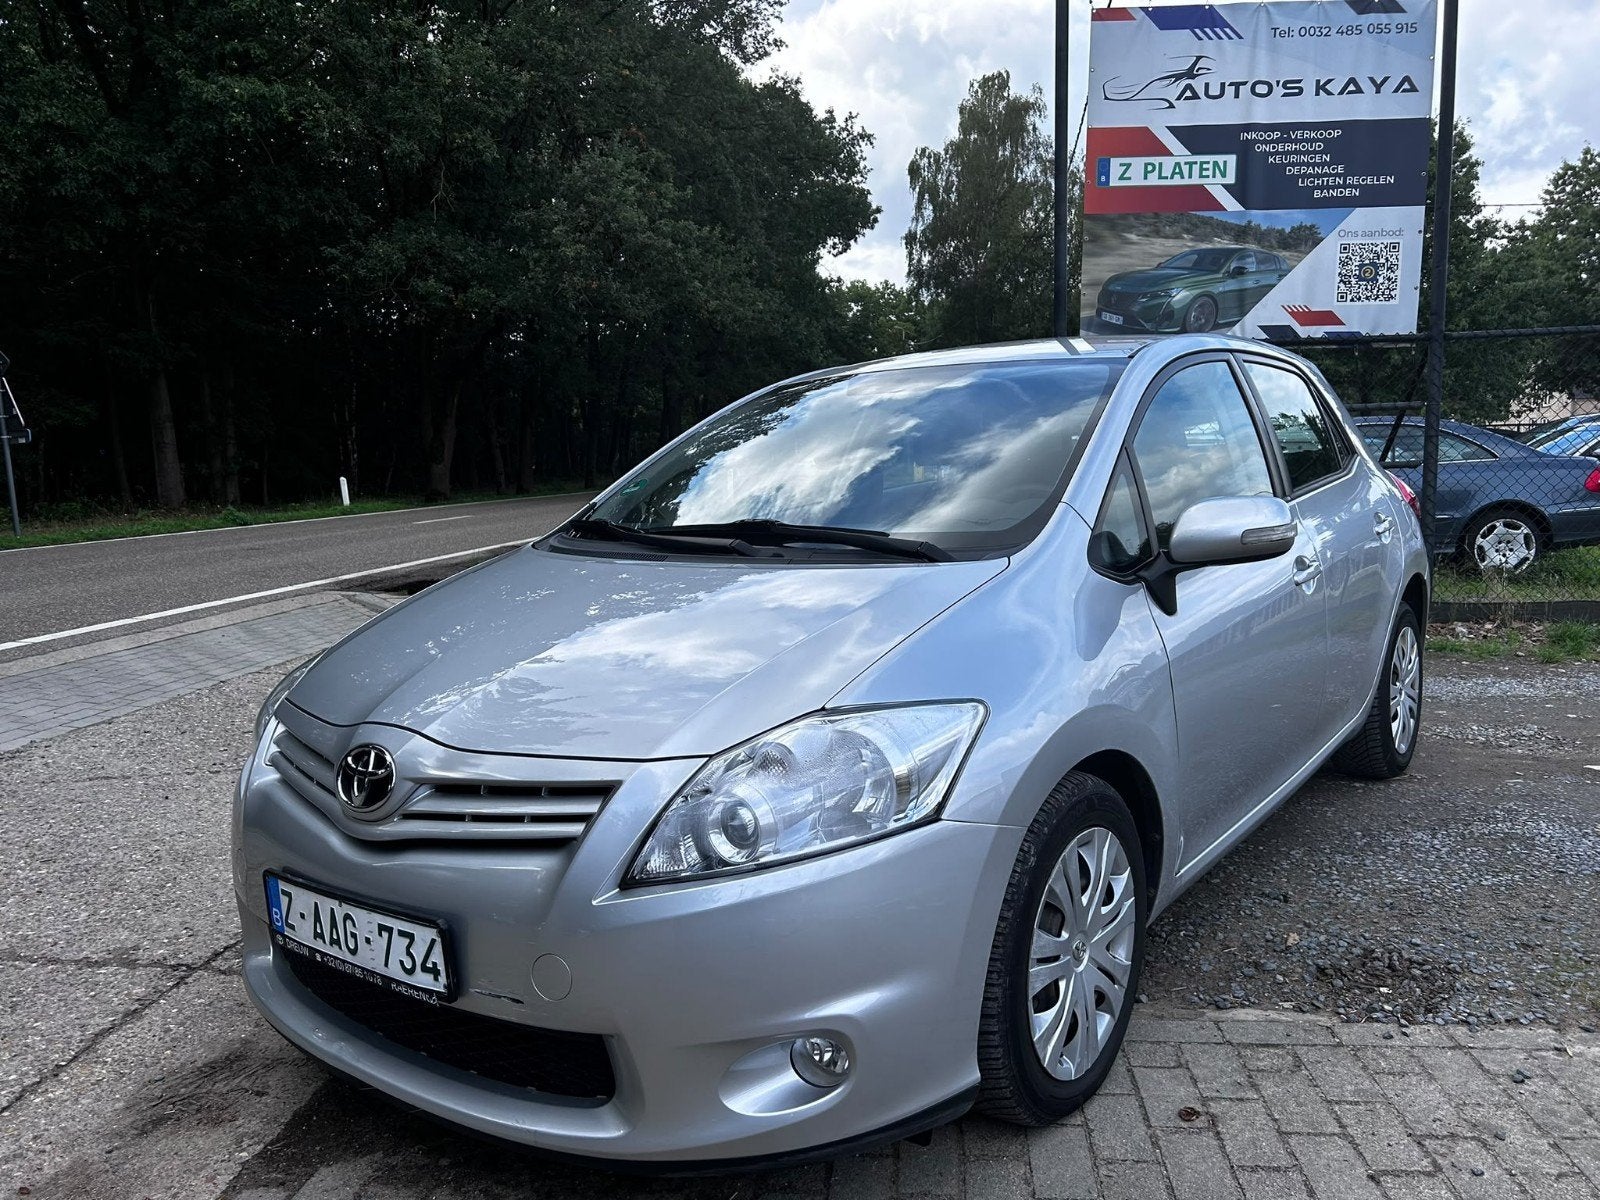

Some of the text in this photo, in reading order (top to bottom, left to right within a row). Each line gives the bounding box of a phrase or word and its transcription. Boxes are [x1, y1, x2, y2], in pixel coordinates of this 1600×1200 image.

[1271, 22, 1417, 38] Tel: 0032 485 055 915
[1175, 74, 1419, 101] AUTO'S KAYA
[1240, 131, 1281, 141] INKOOP
[1289, 129, 1342, 139] VERKOOP
[1255, 142, 1324, 152] ONDERHOUD
[1268, 154, 1330, 164] KEURINGEN
[1118, 160, 1228, 181] Z PLATEN
[1286, 165, 1345, 175] DEPANAGE
[1298, 175, 1395, 187] LICHTEN REGELEN
[1313, 188, 1359, 198] BANDEN
[1337, 227, 1404, 238] Ons aanbod:
[272, 907, 282, 927] B
